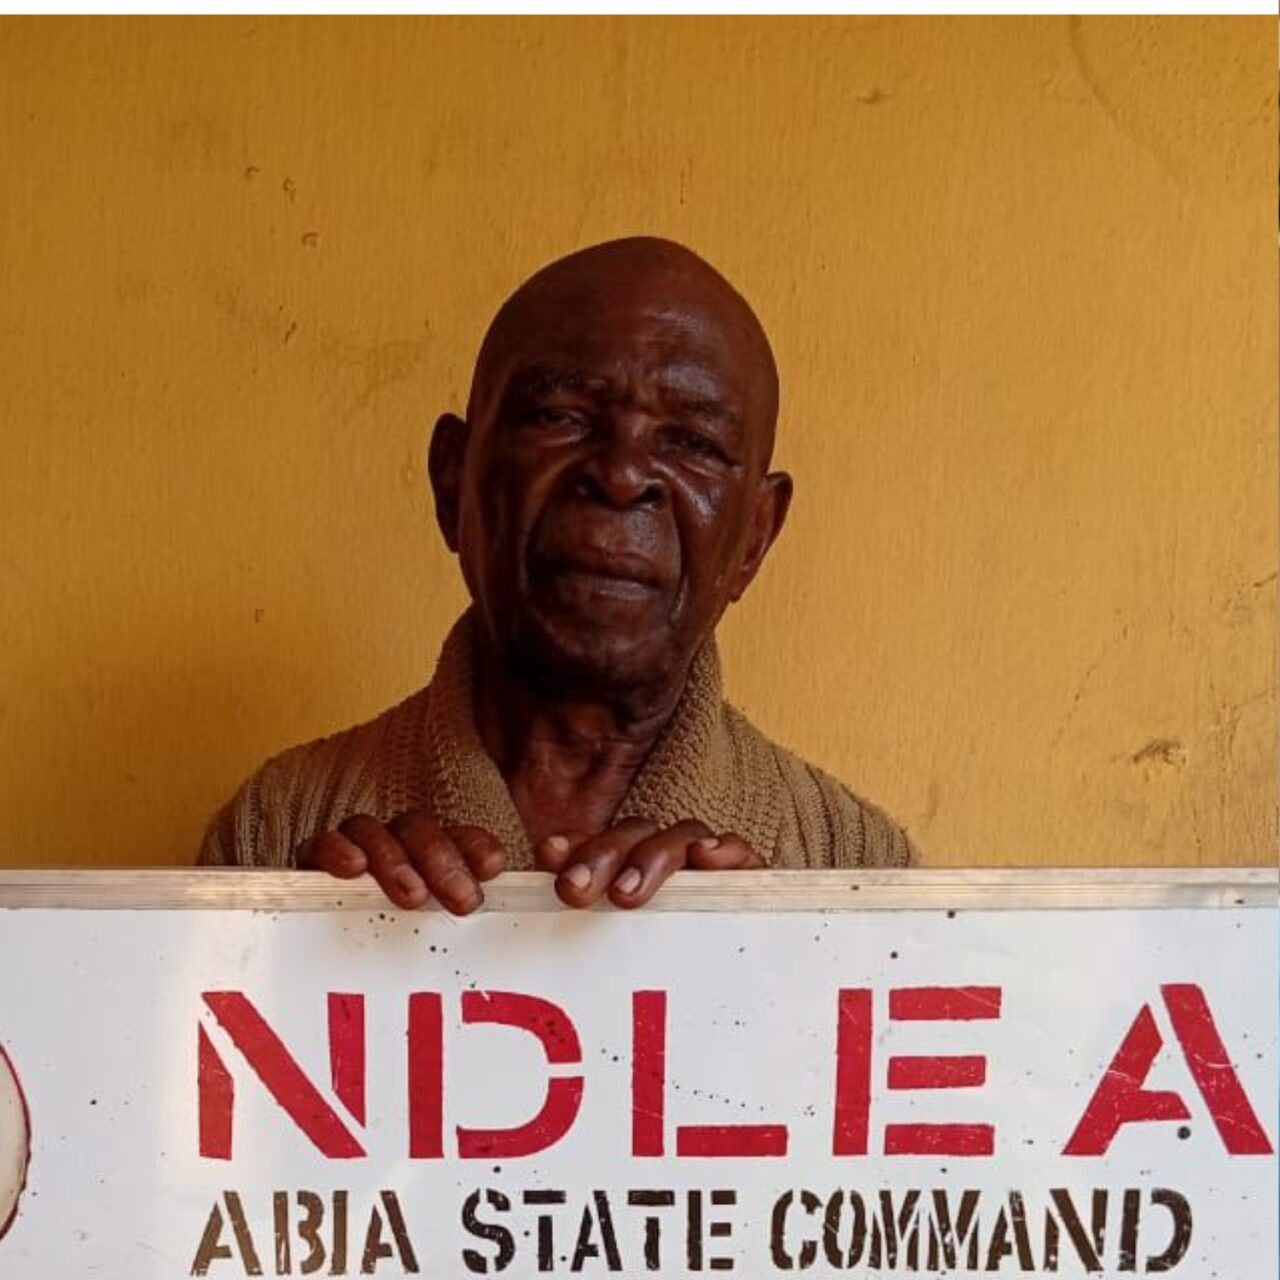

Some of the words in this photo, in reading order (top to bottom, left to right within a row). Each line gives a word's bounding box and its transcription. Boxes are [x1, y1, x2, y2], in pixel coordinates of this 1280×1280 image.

[198, 983, 1275, 1161] NDLEA
[190, 1190, 419, 1276] ABIA
[461, 1187, 737, 1273] STATE
[769, 1187, 1193, 1273] COMMAND
